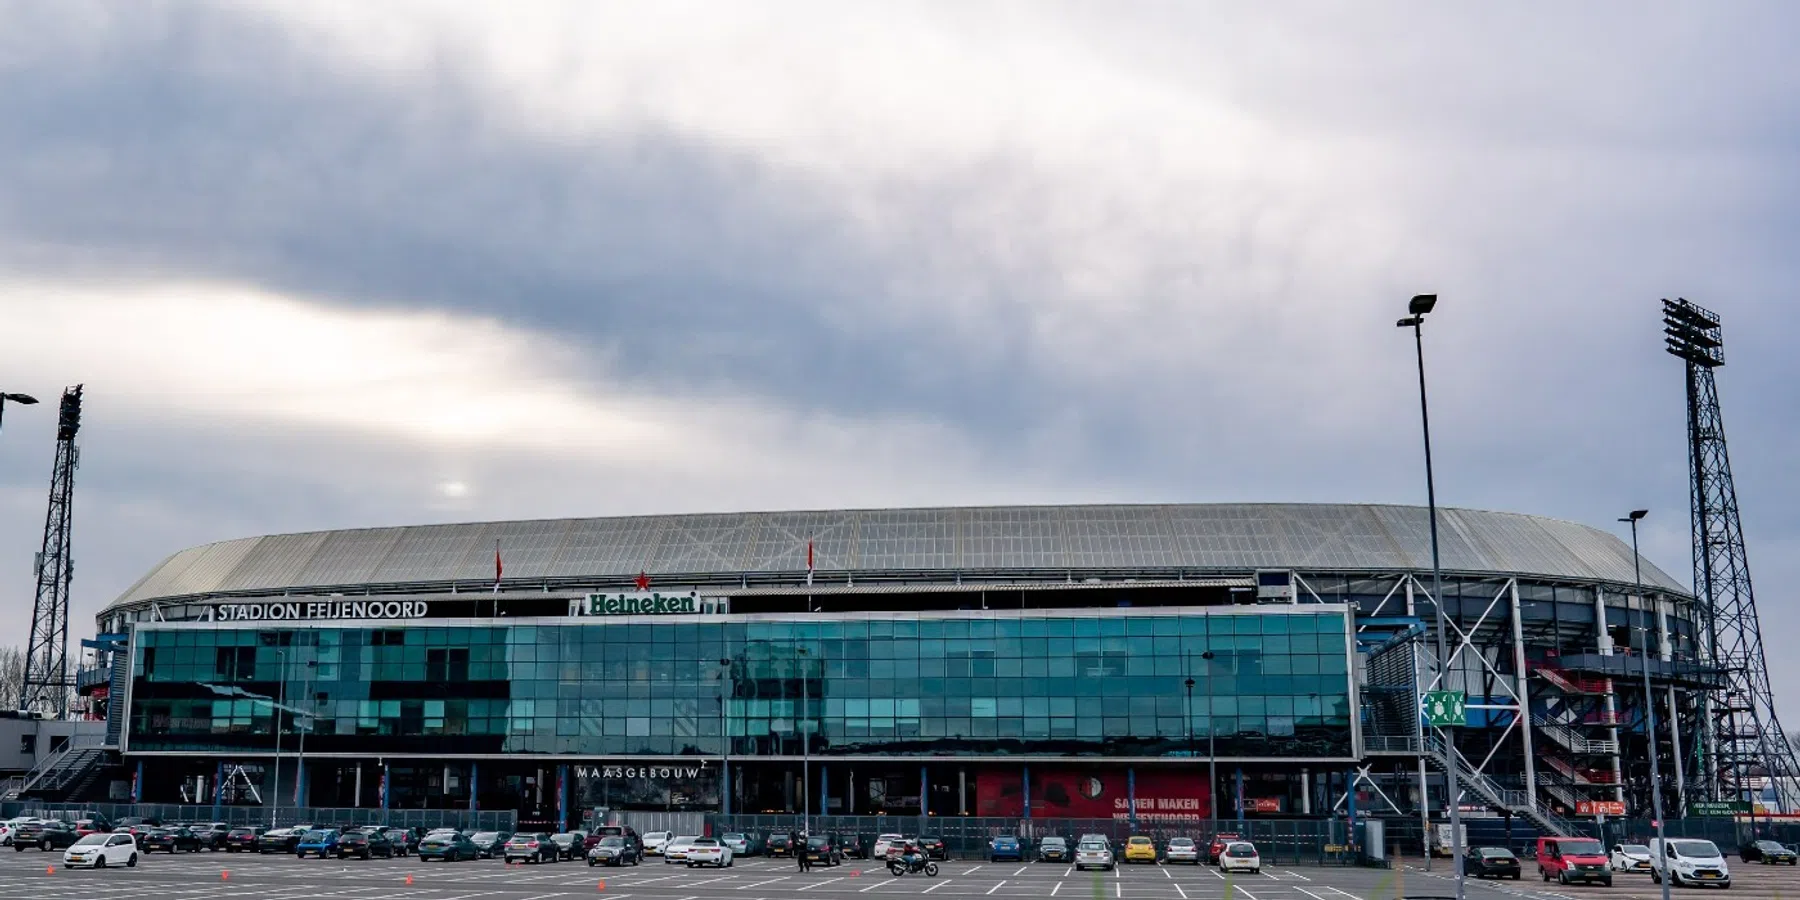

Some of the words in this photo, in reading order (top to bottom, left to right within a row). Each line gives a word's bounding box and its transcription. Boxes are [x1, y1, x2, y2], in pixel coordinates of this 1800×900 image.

[217, 603, 300, 621] STADION
[306, 601, 428, 619] FEIJENOORD
[590, 593, 695, 613] Heineken
[577, 767, 699, 779] MAASGEBOUW
[1158, 798, 1200, 810] MAKEN
